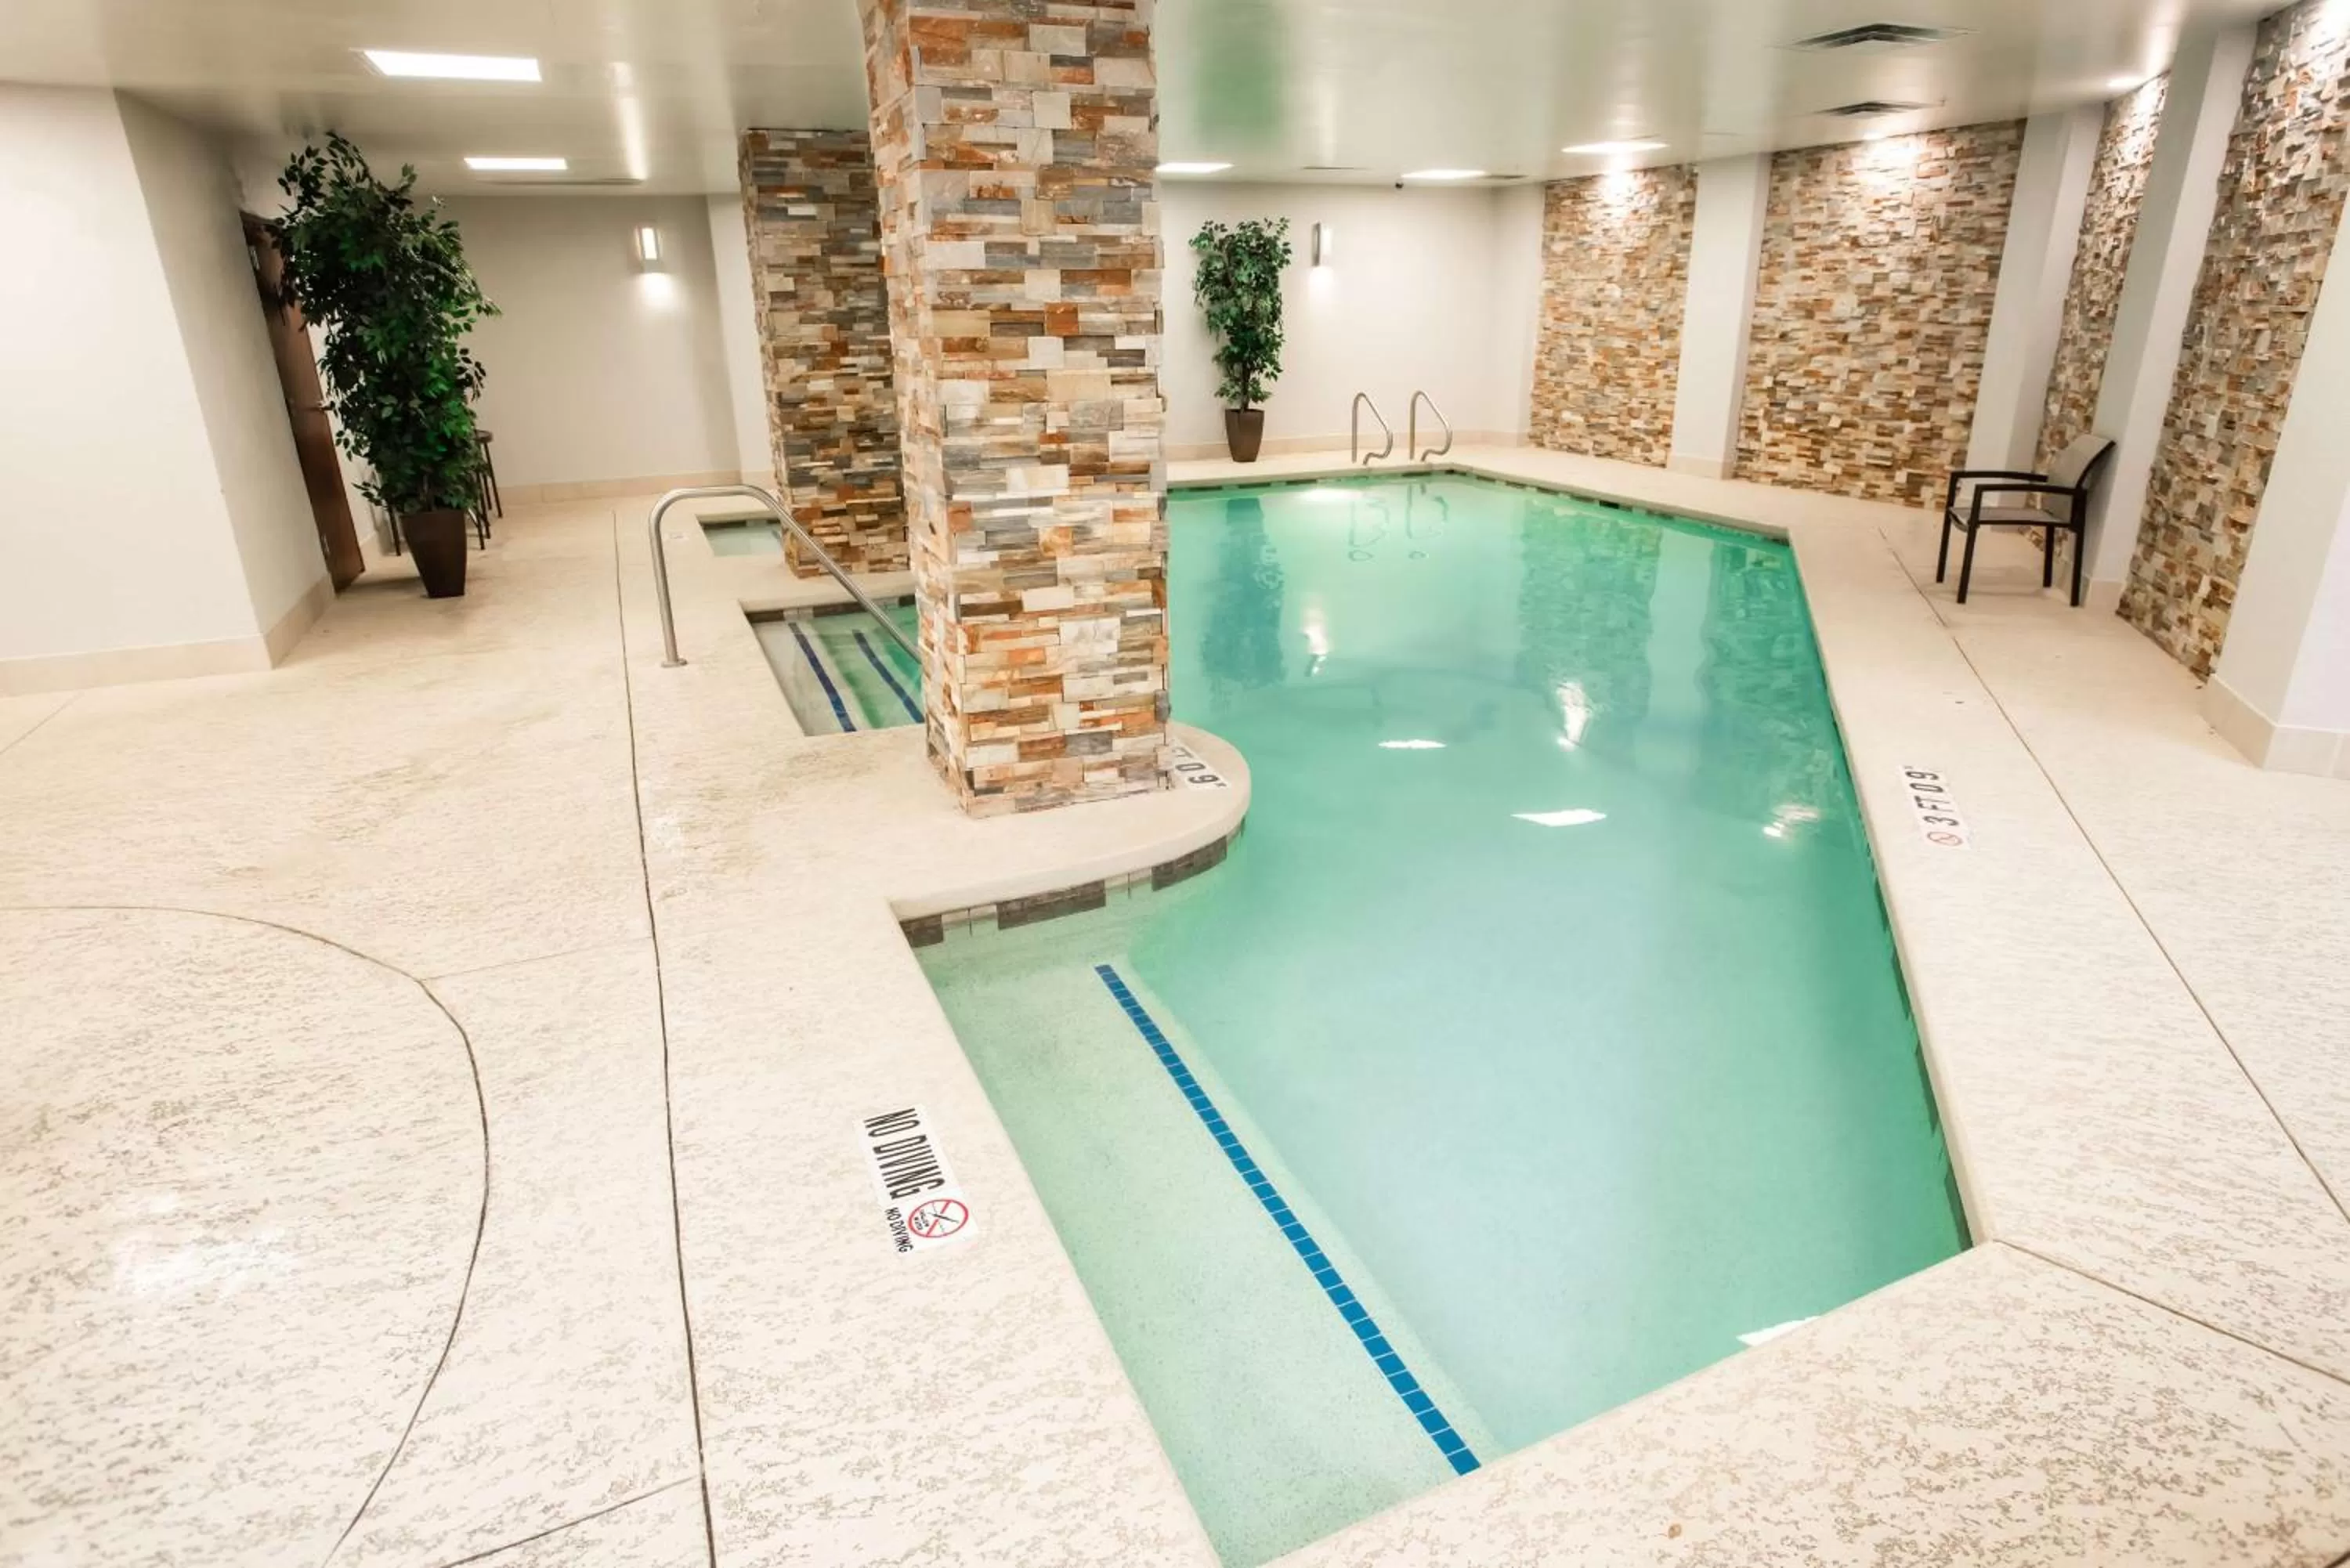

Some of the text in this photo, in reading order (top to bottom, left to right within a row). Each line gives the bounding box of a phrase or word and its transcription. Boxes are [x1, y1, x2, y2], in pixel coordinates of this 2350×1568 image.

[1914, 795, 1954, 812] FT
[1922, 815, 1959, 826] 3
[863, 1107, 945, 1200] NO DIVING
[884, 1207, 914, 1252] NO DIVING
